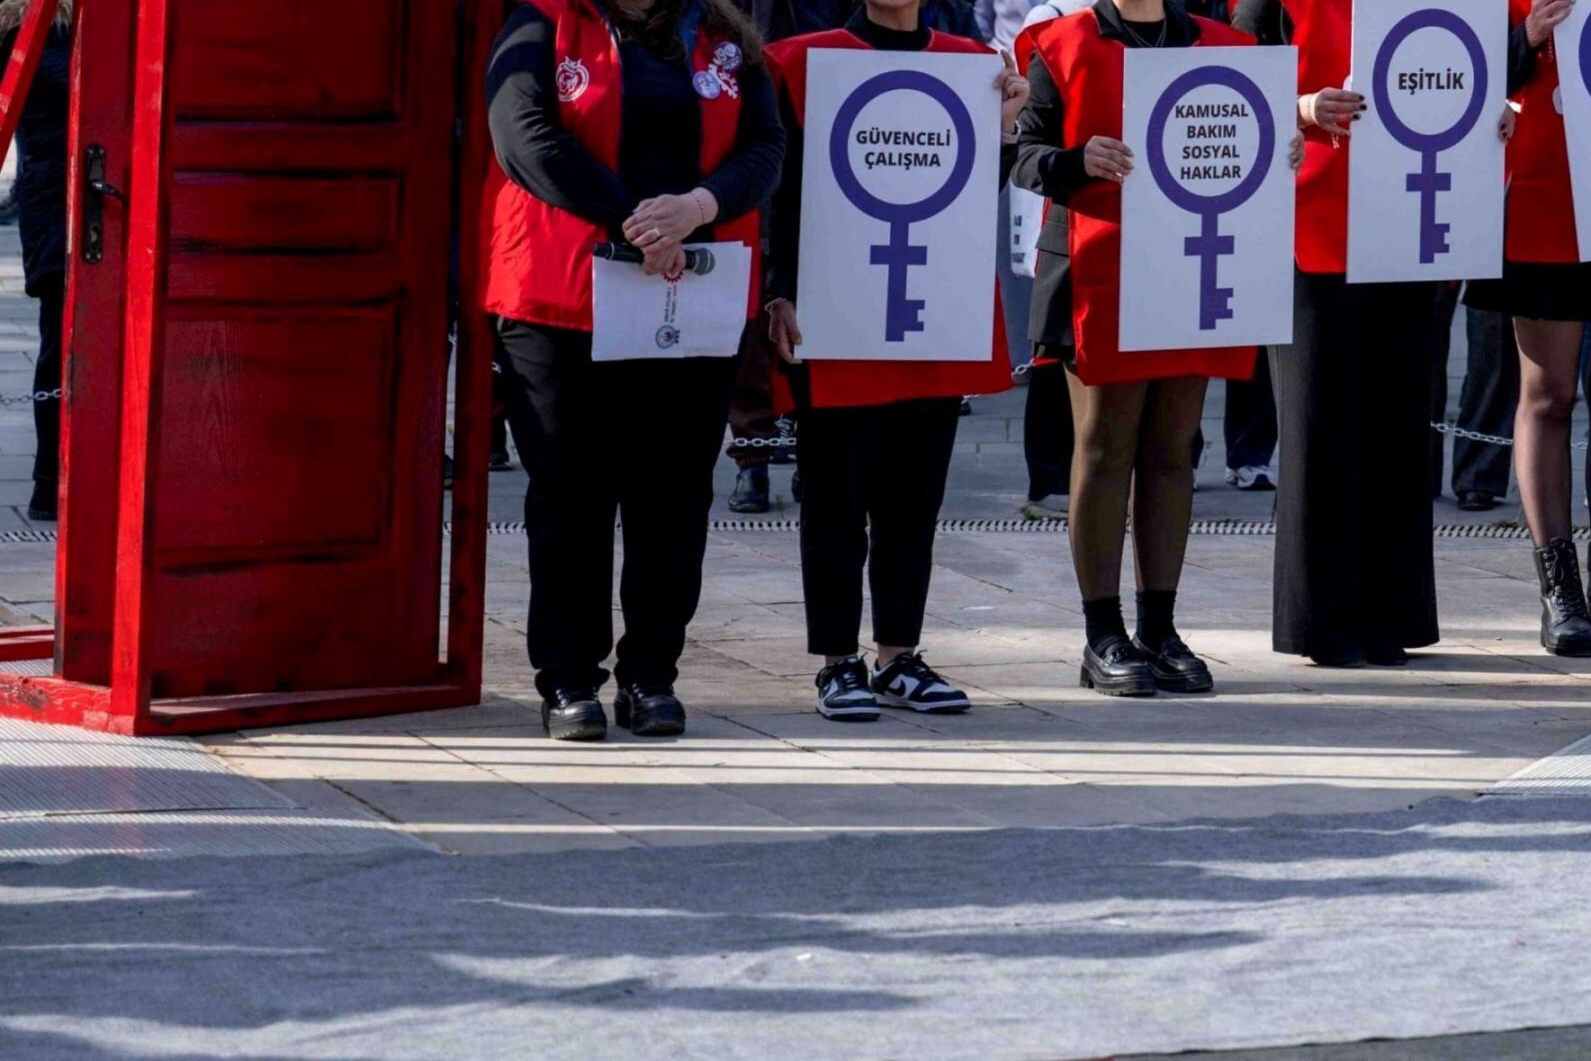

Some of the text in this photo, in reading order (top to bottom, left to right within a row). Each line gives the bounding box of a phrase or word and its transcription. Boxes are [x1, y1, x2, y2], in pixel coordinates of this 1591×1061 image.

[1398, 68, 1464, 95] EŞİTLİK
[1175, 103, 1249, 118] KAMUSAL
[856, 127, 951, 146] GÜVENCELİ
[1187, 124, 1237, 139] BAKIM
[1182, 144, 1240, 159] SOSYAL
[864, 152, 941, 171] ÇALIŞMA
[1180, 165, 1242, 180] HAKLAR
